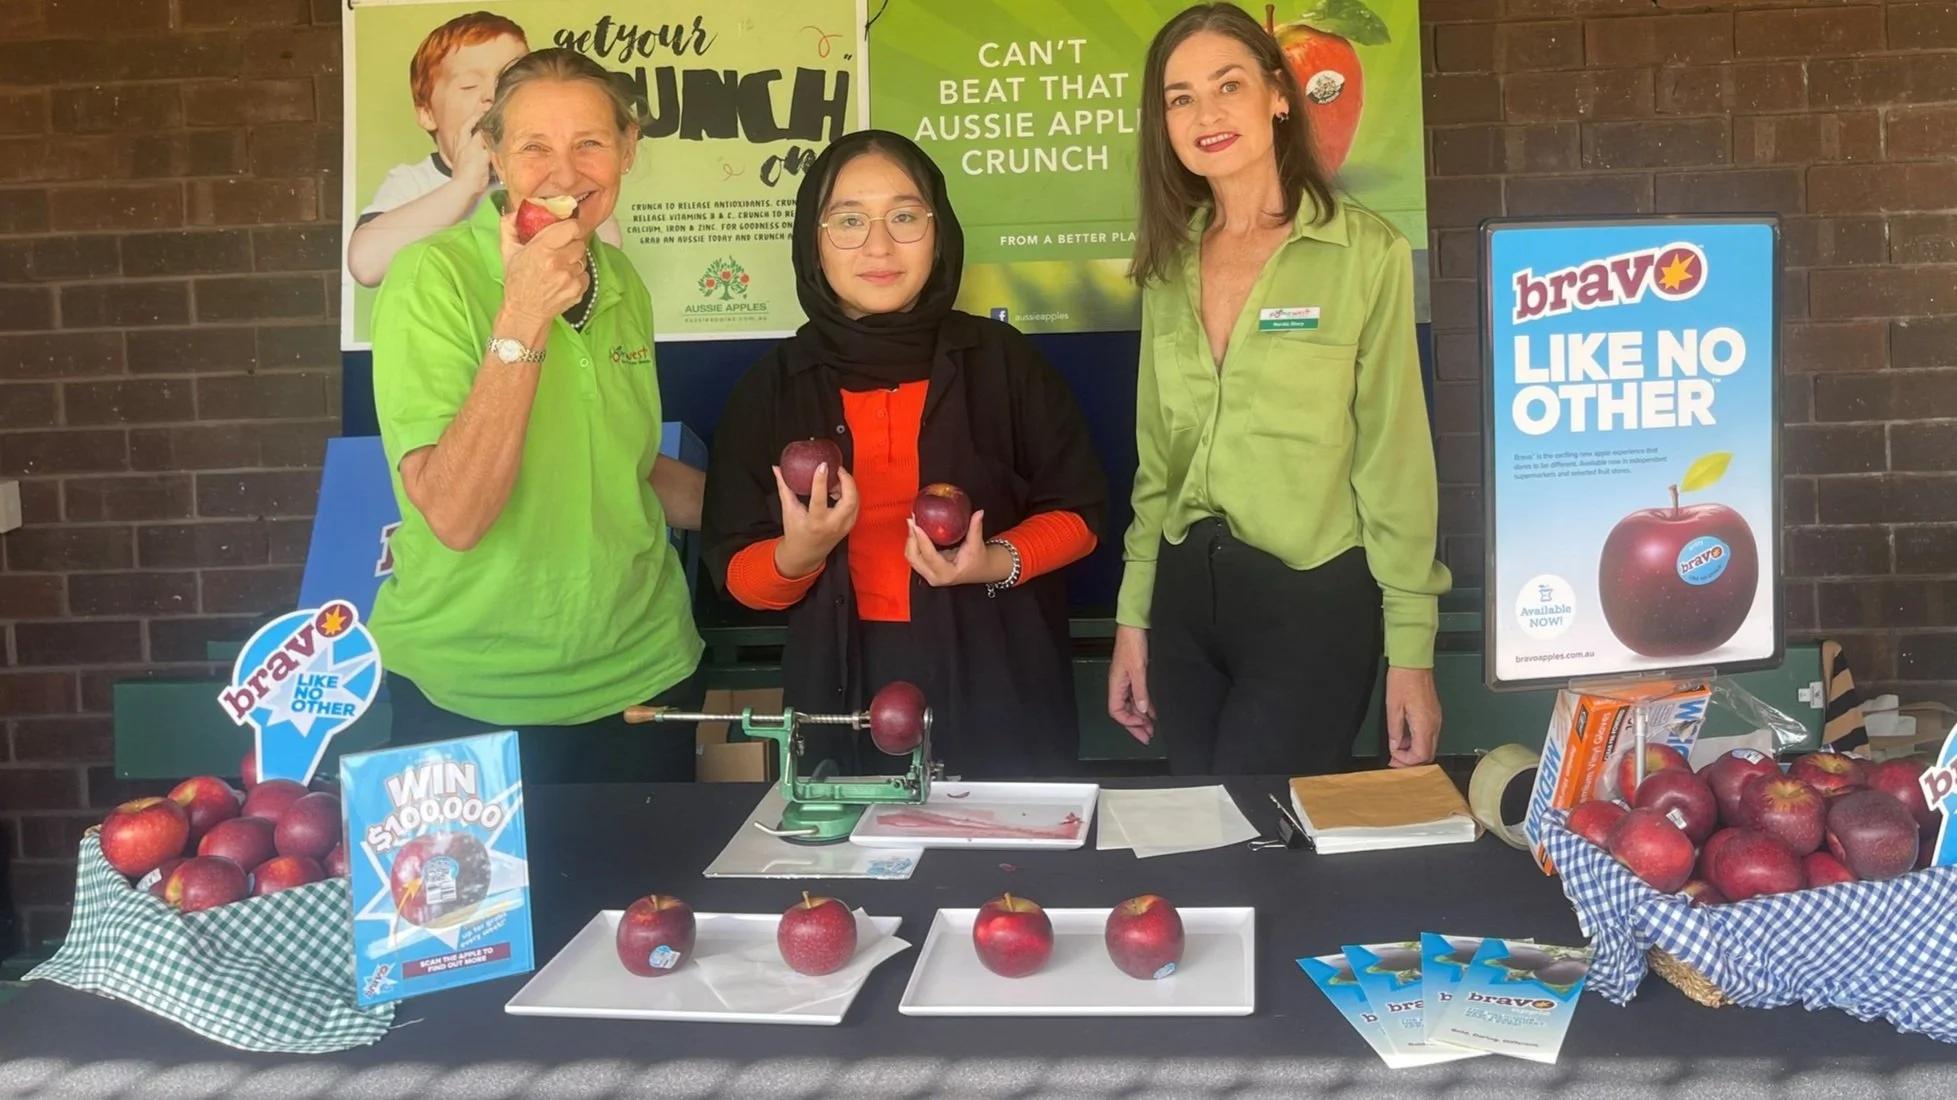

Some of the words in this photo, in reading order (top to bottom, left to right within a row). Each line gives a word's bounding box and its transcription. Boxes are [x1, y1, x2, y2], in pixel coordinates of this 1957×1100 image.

[978, 39, 1087, 68] CAN'T
[939, 78, 1026, 105] BEAT
[1040, 72, 1130, 100] THAT
[914, 112, 1035, 141] AUSSIE
[962, 146, 1108, 176] CRUNCH
[631, 203, 662, 211] CRUNCH
[665, 202, 675, 210] TO
[678, 201, 711, 210] RELEASE
[775, 199, 797, 207] CRUN
[633, 213, 666, 222] RELEASE
[670, 212, 707, 221] VITAMINS
[738, 211, 770, 219] CRUNCH
[666, 224, 686, 232] IRON
[721, 223, 737, 231] FOR
[739, 222, 779, 230] GOODNESS
[639, 237, 660, 245] GRAB
[663, 236, 675, 244] AN
[677, 235, 705, 243] AUSSIE
[708, 234, 733, 243] TODAY
[735, 233, 751, 242] AND
[754, 232, 785, 241] CRUNCH
[1000, 235, 1038, 246] FROM
[1043, 235, 1053, 245] A
[1058, 232, 1106, 244] BETTER
[1112, 232, 1136, 242] PLA
[1515, 247, 1703, 319] bravo
[685, 304, 723, 313] AUSSIE
[725, 303, 767, 312] APPLES
[1015, 312, 1070, 323] aussieapples
[1514, 330, 1644, 384] LIKE
[1657, 327, 1746, 379] NO
[1681, 546, 1723, 574] bravo
[1520, 603, 1572, 617] Available
[1529, 616, 1564, 628] NOW!
[224, 603, 354, 720] bravo
[1515, 650, 1595, 664] bravoapples.com.au
[298, 673, 338, 689] LIKE
[294, 687, 324, 700] NO
[291, 700, 356, 717] OTHER
[388, 763, 476, 807] WIN
[367, 796, 502, 853] $100,000
[420, 958, 442, 969] SCAN
[442, 955, 458, 964] THE
[458, 950, 482, 962] APPLE
[482, 946, 494, 954] TO
[427, 964, 447, 973] FIND
[447, 961, 463, 969] OUT
[464, 955, 487, 966] MORE
[1469, 992, 1556, 1009] bravo
